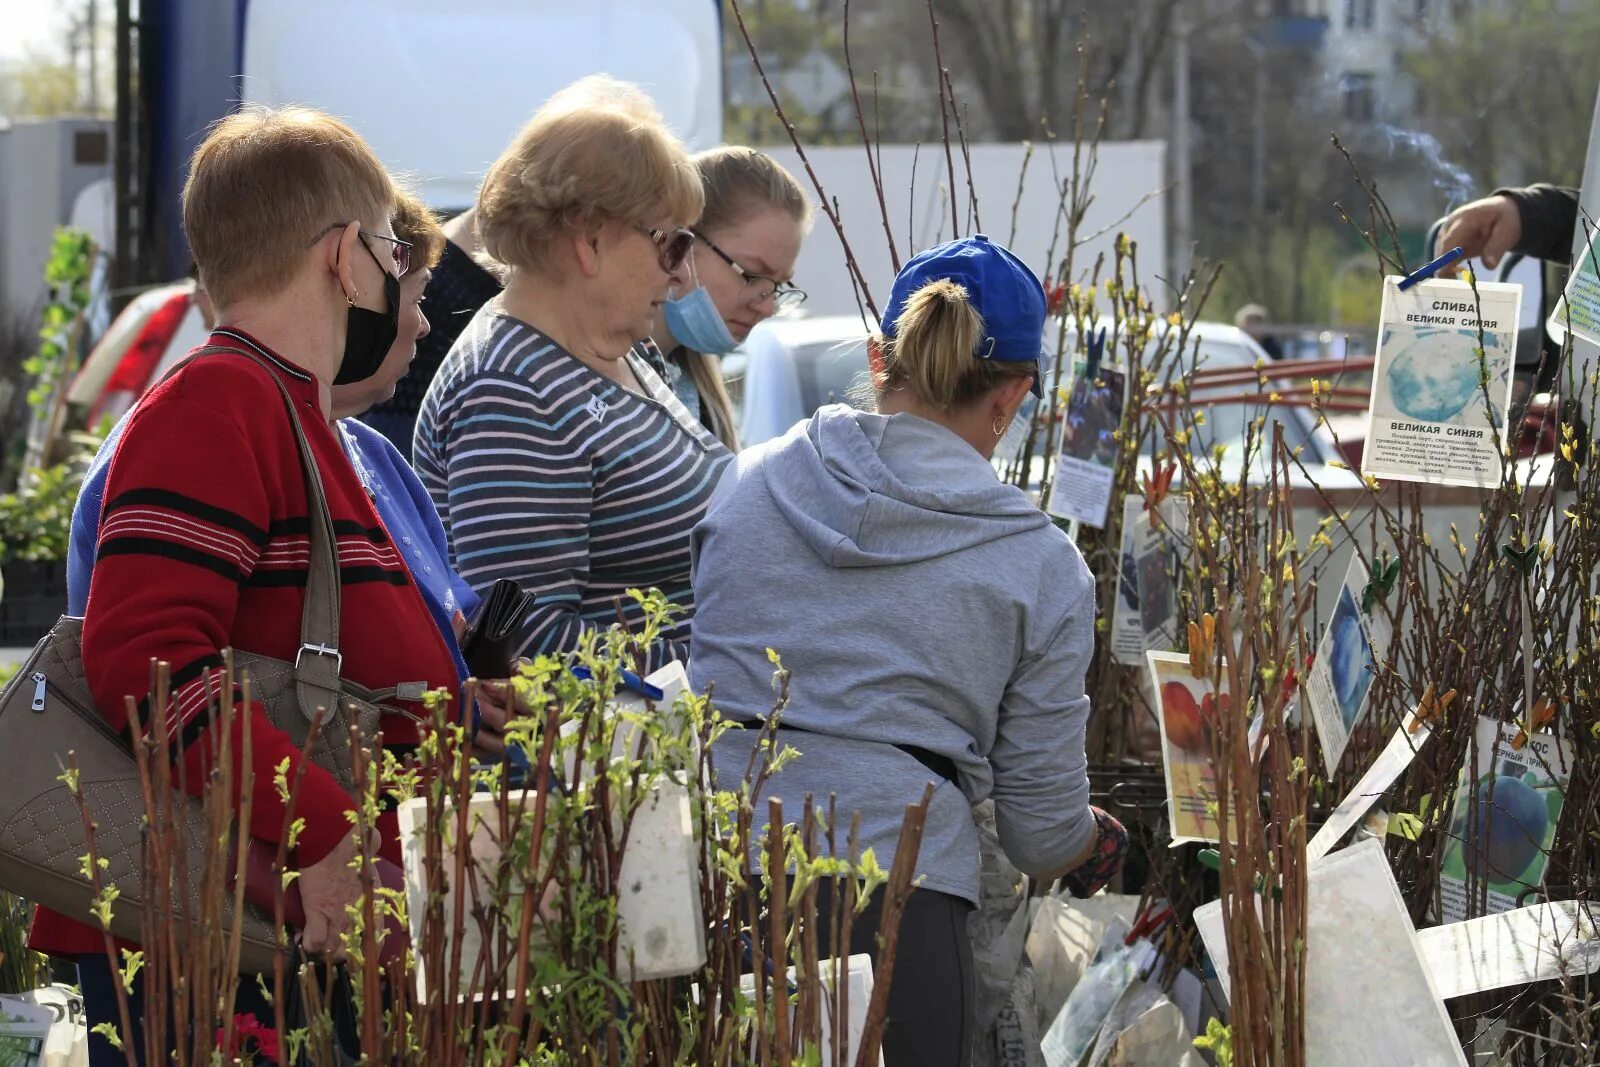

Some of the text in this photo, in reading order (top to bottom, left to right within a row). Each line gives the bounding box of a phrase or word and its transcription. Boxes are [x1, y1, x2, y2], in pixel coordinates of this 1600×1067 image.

[1432, 301, 1475, 314] СЛИВА
[1406, 314, 1498, 329] ВЕЛИКАЯ СИНЯЯ
[1390, 422, 1484, 439] ВЕЛИКАЯ СИНЯЯ
[1496, 749, 1524, 762] ЕРНЫЙ
